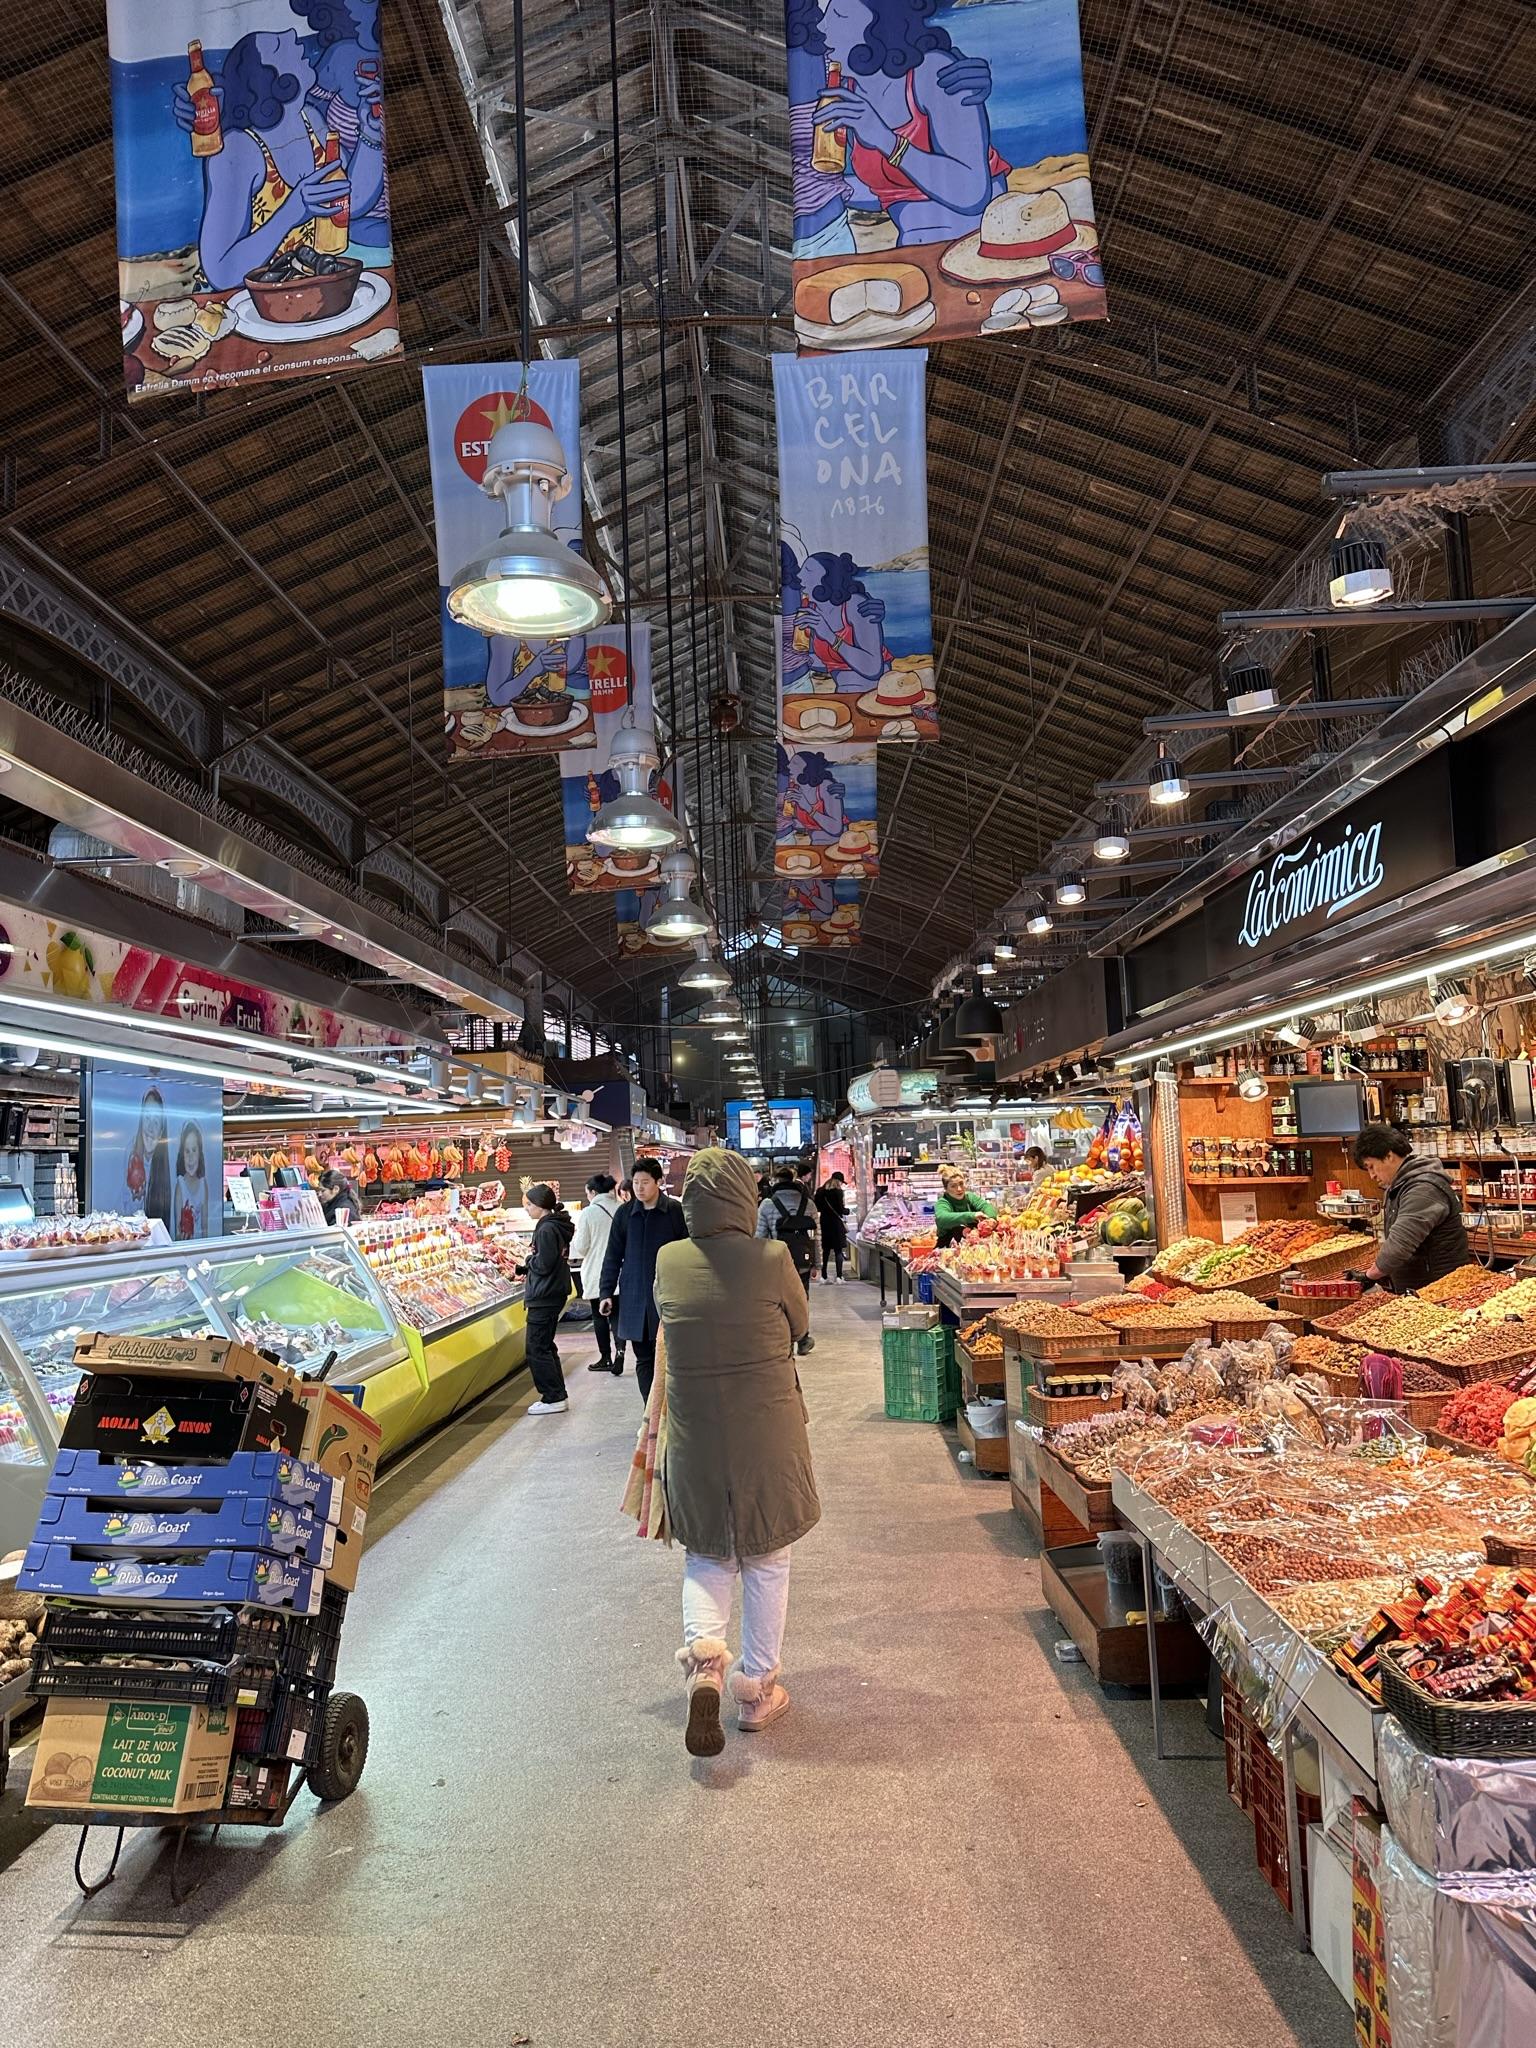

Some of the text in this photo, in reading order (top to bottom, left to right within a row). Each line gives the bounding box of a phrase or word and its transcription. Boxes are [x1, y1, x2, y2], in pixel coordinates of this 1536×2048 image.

[172, 377, 200, 389] Damm
[216, 366, 260, 381] recomana
[263, 365, 271, 373] el
[273, 358, 310, 372] consum
[805, 373, 897, 410] BAR
[814, 411, 898, 449] CEL
[816, 451, 902, 490] ONA
[831, 495, 885, 518] 1876
[182, 988, 218, 1021] Sprim
[236, 1007, 262, 1031] Fruit
[97, 1416, 139, 1430] MOLLA
[144, 1473, 202, 1486] Plus Coast
[291, 1473, 320, 1492] Plus Coast
[130, 1521, 190, 1534] Plus Coast
[281, 1521, 312, 1540] Plus Coast
[117, 1571, 178, 1584] Plus Coast
[269, 1570, 300, 1587] Plus Coast
[129, 1711, 167, 1722] AROY-D
[112, 1739, 178, 1752] LAIT DE NOIX
[120, 1752, 161, 1764] DE COCO
[101, 1767, 173, 1780] COCONUT MILK
